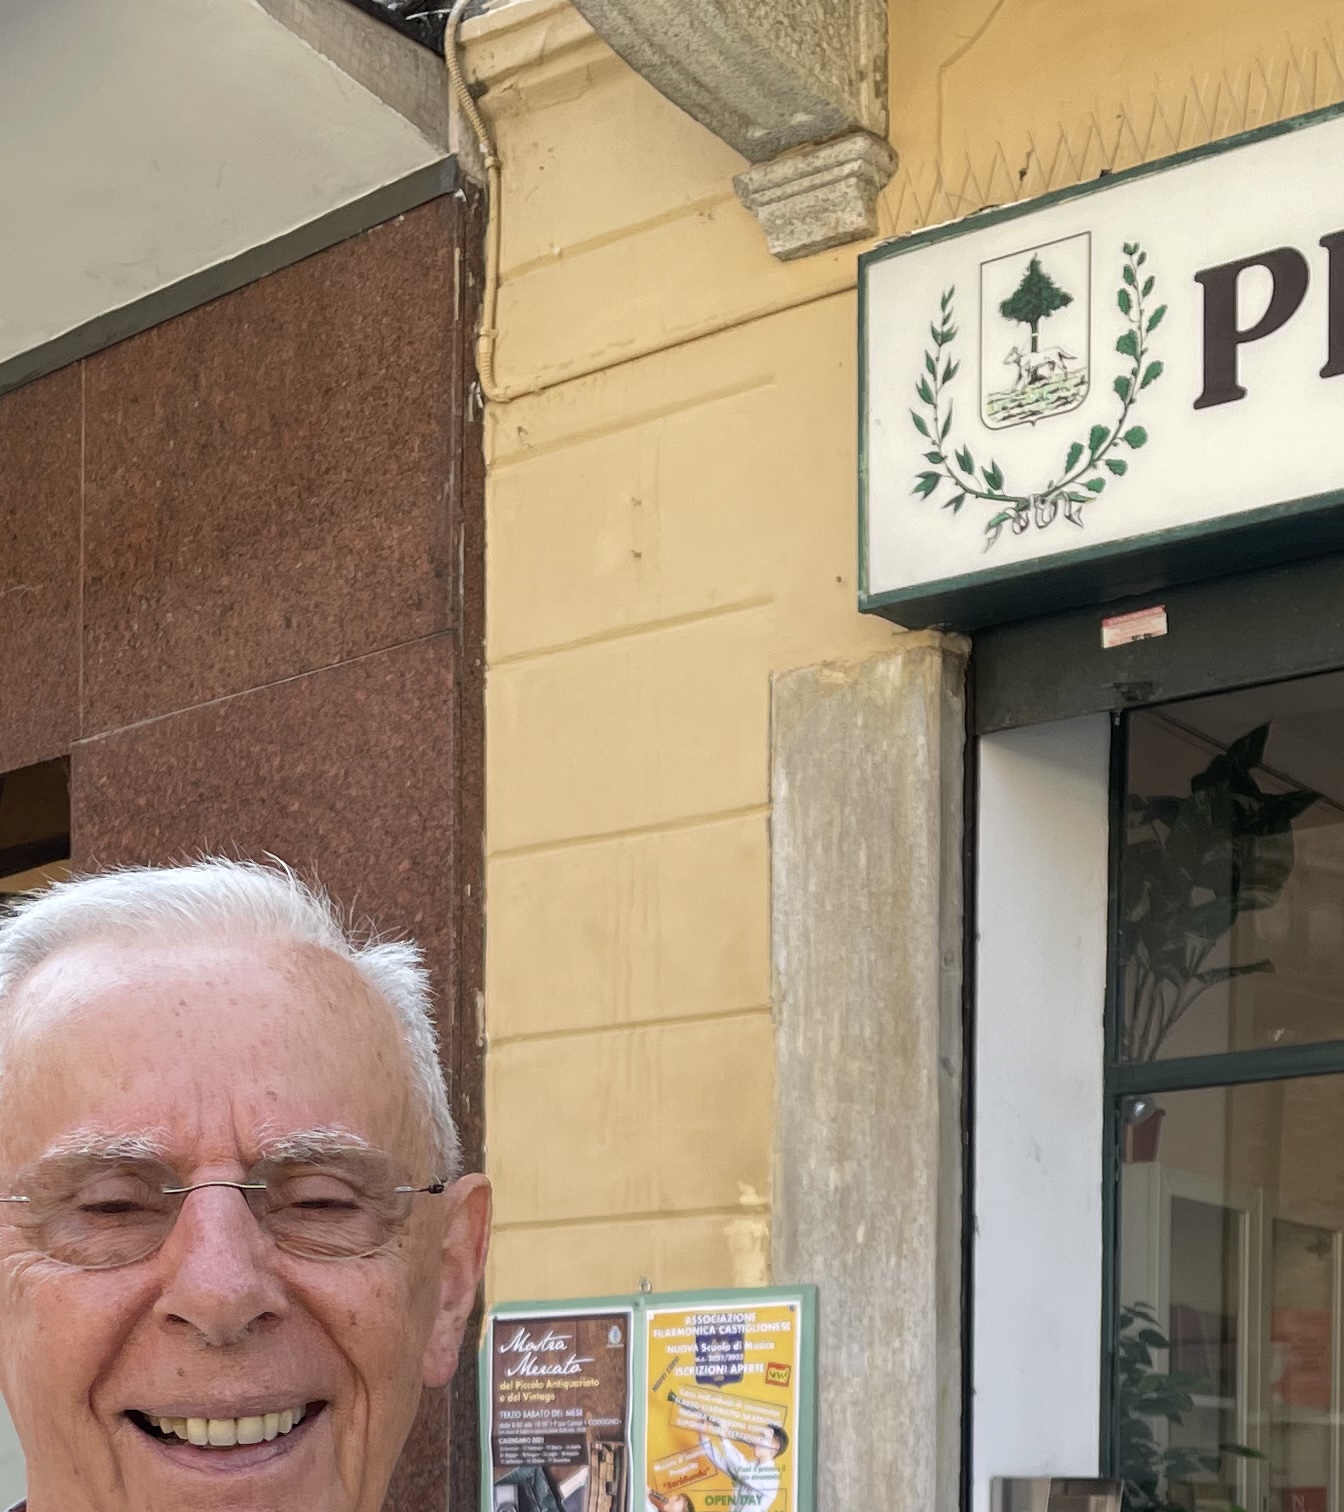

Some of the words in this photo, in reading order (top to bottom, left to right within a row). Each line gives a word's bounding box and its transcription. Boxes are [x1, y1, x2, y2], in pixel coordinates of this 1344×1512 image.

[685, 1312, 756, 1325] ASSOCIAZIONE
[654, 1324, 715, 1338] FILARMONICA
[719, 1321, 791, 1335] CASTIGLIONESE
[499, 1327, 573, 1354] Mostra
[701, 1341, 730, 1353] Scuola
[733, 1340, 742, 1351] di
[506, 1351, 596, 1377] Mercato
[676, 1366, 727, 1377] ISCRIZIONI
[730, 1363, 764, 1374] APERTE
[499, 1380, 513, 1391] del
[516, 1380, 544, 1390] Piccolo
[704, 1495, 736, 1506] OPEN
[739, 1494, 762, 1506] DAY
